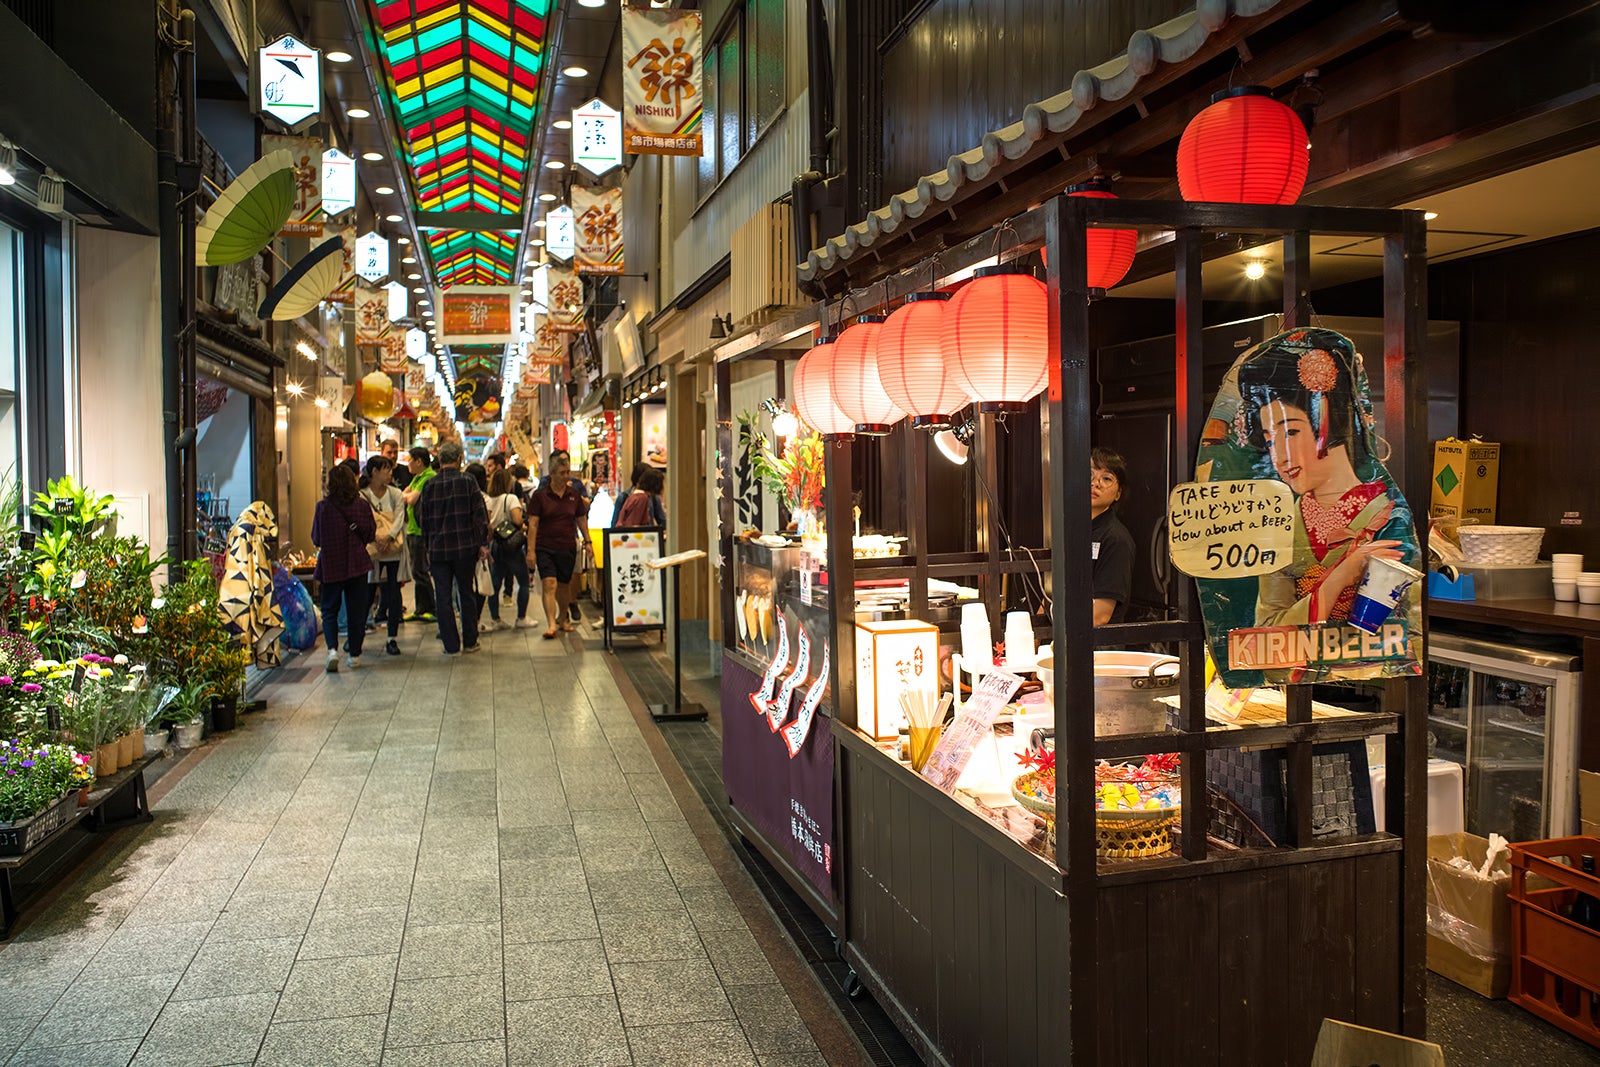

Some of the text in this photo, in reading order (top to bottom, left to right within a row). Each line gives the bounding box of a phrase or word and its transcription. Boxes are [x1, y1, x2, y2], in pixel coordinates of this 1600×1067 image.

[627, 37, 697, 121] 錦
[635, 104, 675, 118] NISHIKI
[631, 135, 697, 150] 錦市場商店街
[575, 203, 619, 256] 錦
[1438, 446, 1463, 455] HATSUTA
[1177, 483, 1256, 506] TAKE OUT
[1172, 514, 1293, 543] How about a BEER?
[1206, 543, 1276, 571] 500円
[1232, 624, 1405, 667] KIRIN BEER
